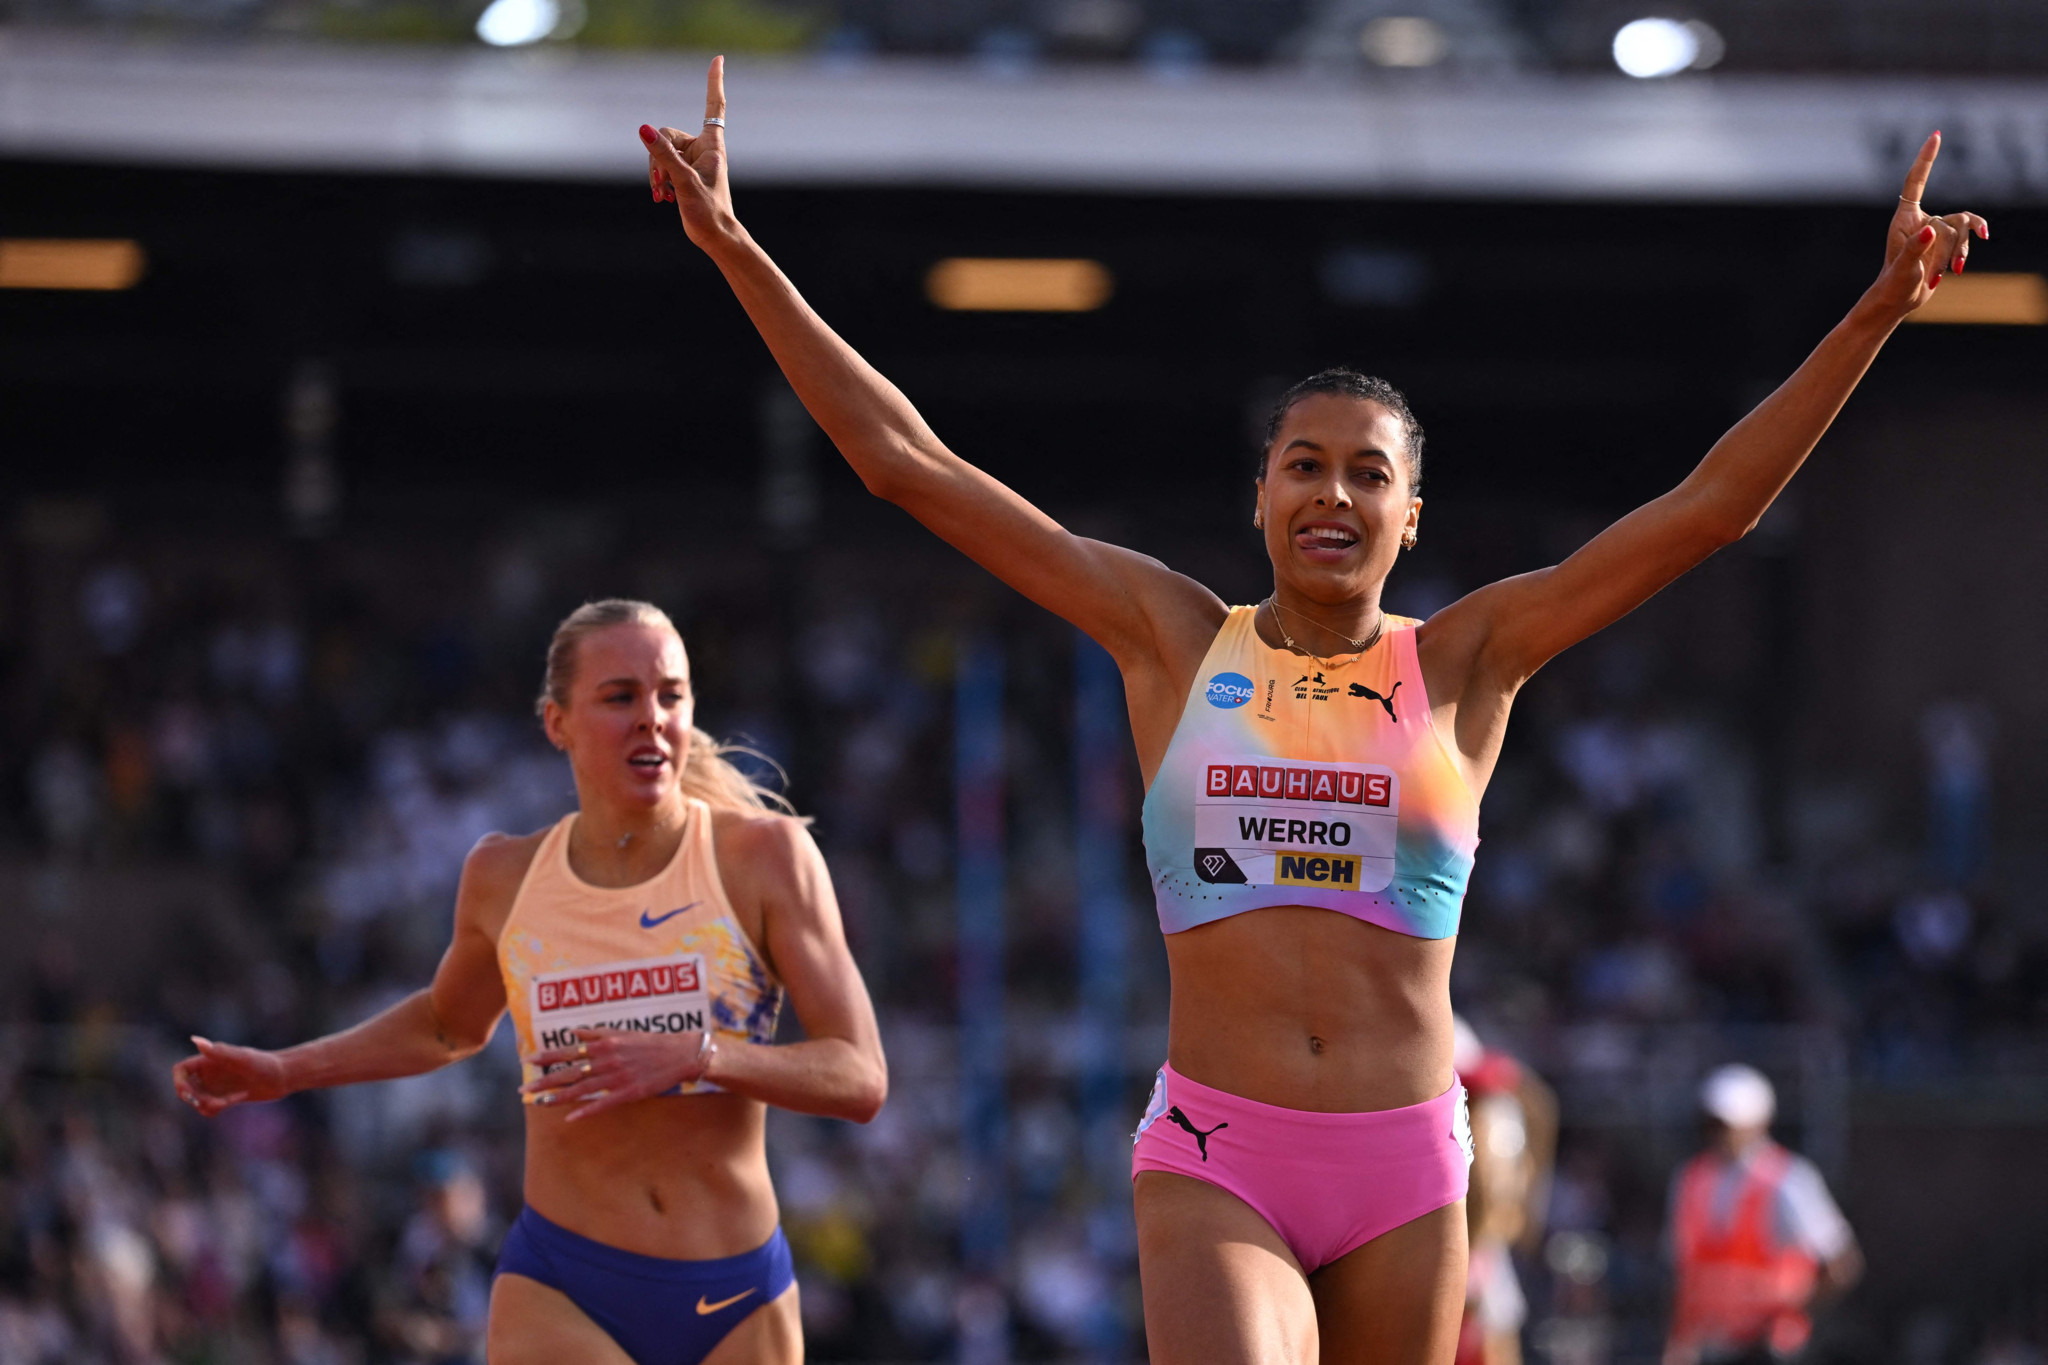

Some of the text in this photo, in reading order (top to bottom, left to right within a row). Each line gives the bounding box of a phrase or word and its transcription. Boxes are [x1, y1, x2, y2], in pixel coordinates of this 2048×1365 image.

[1205, 682, 1254, 698] FOCUS
[1209, 768, 1388, 802] BAUHAUS
[1238, 816, 1351, 847] WERRO
[540, 964, 698, 1009] BAUHAUS
[541, 1009, 704, 1050] HOINSON
